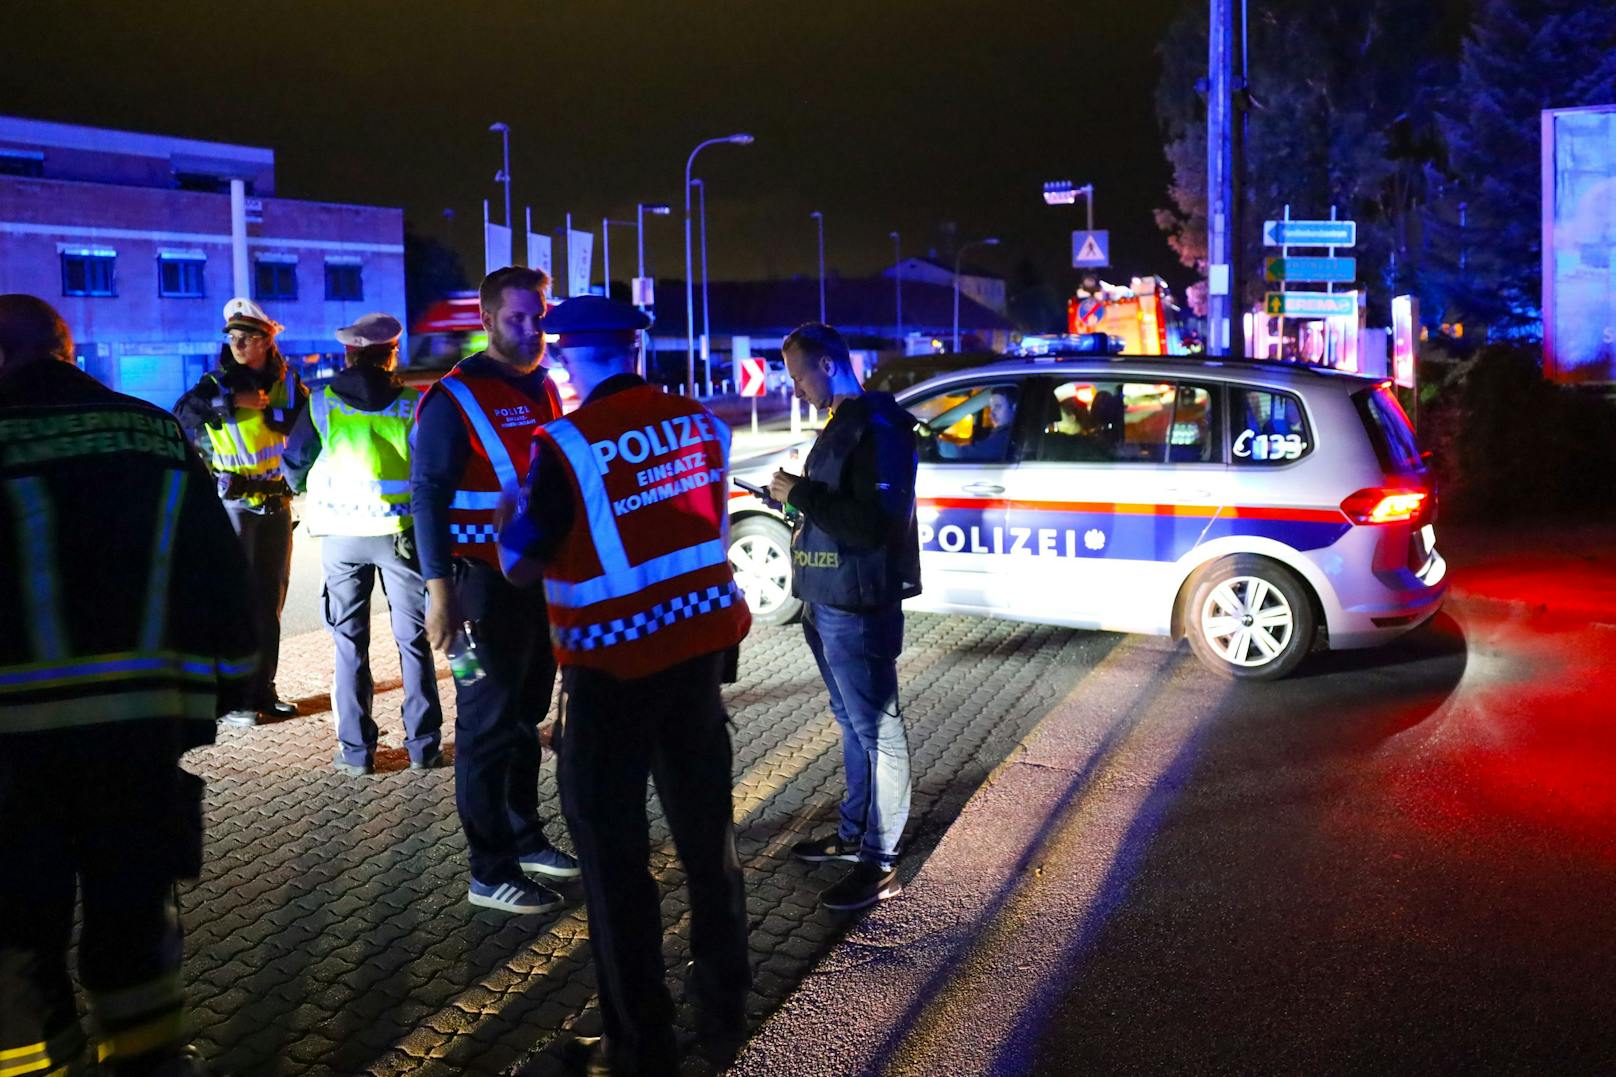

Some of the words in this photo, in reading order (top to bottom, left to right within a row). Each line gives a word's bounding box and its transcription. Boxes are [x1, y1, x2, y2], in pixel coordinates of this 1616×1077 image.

[495, 405, 531, 417] POLIZE
[590, 411, 718, 475] POLIZE
[1252, 433, 1303, 460] 133
[918, 523, 1077, 557] POLIZEI
[793, 550, 839, 568] POLIZEI
